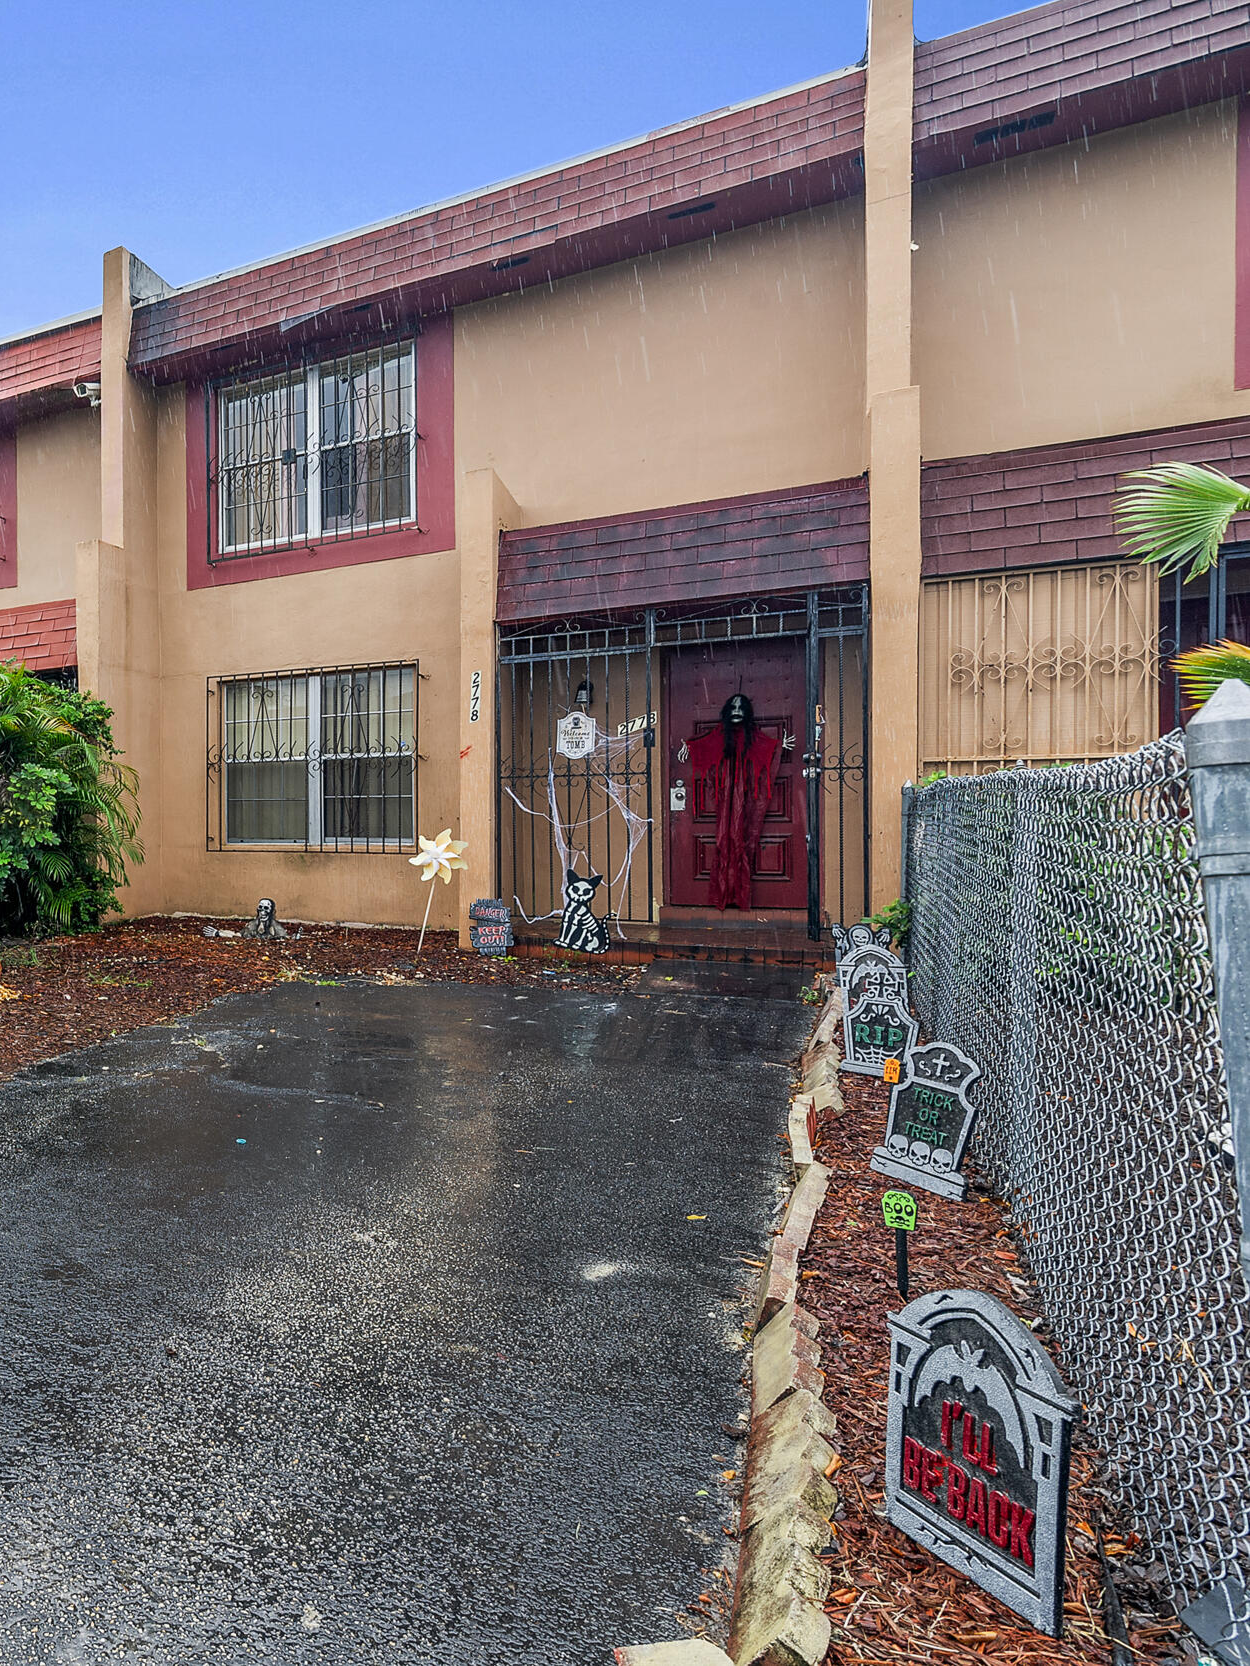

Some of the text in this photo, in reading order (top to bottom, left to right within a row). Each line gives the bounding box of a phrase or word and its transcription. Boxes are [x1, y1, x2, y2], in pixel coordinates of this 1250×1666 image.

[470, 672, 480, 722] 2778
[560, 729, 590, 737] Welcome
[619, 713, 656, 736] 2778
[565, 740, 586, 749] TOMB
[475, 906, 505, 919] DANGER
[478, 925, 506, 935] KEEP
[479, 935, 505, 946] OUT!
[854, 1023, 903, 1047] RIP
[913, 1086, 955, 1112] TRICK
[918, 1107, 939, 1125] OR
[904, 1121, 949, 1146] TREAT
[884, 1201, 914, 1217] BOO
[940, 1400, 999, 1477] I'LL
[903, 1435, 1035, 1568] BE BACK
